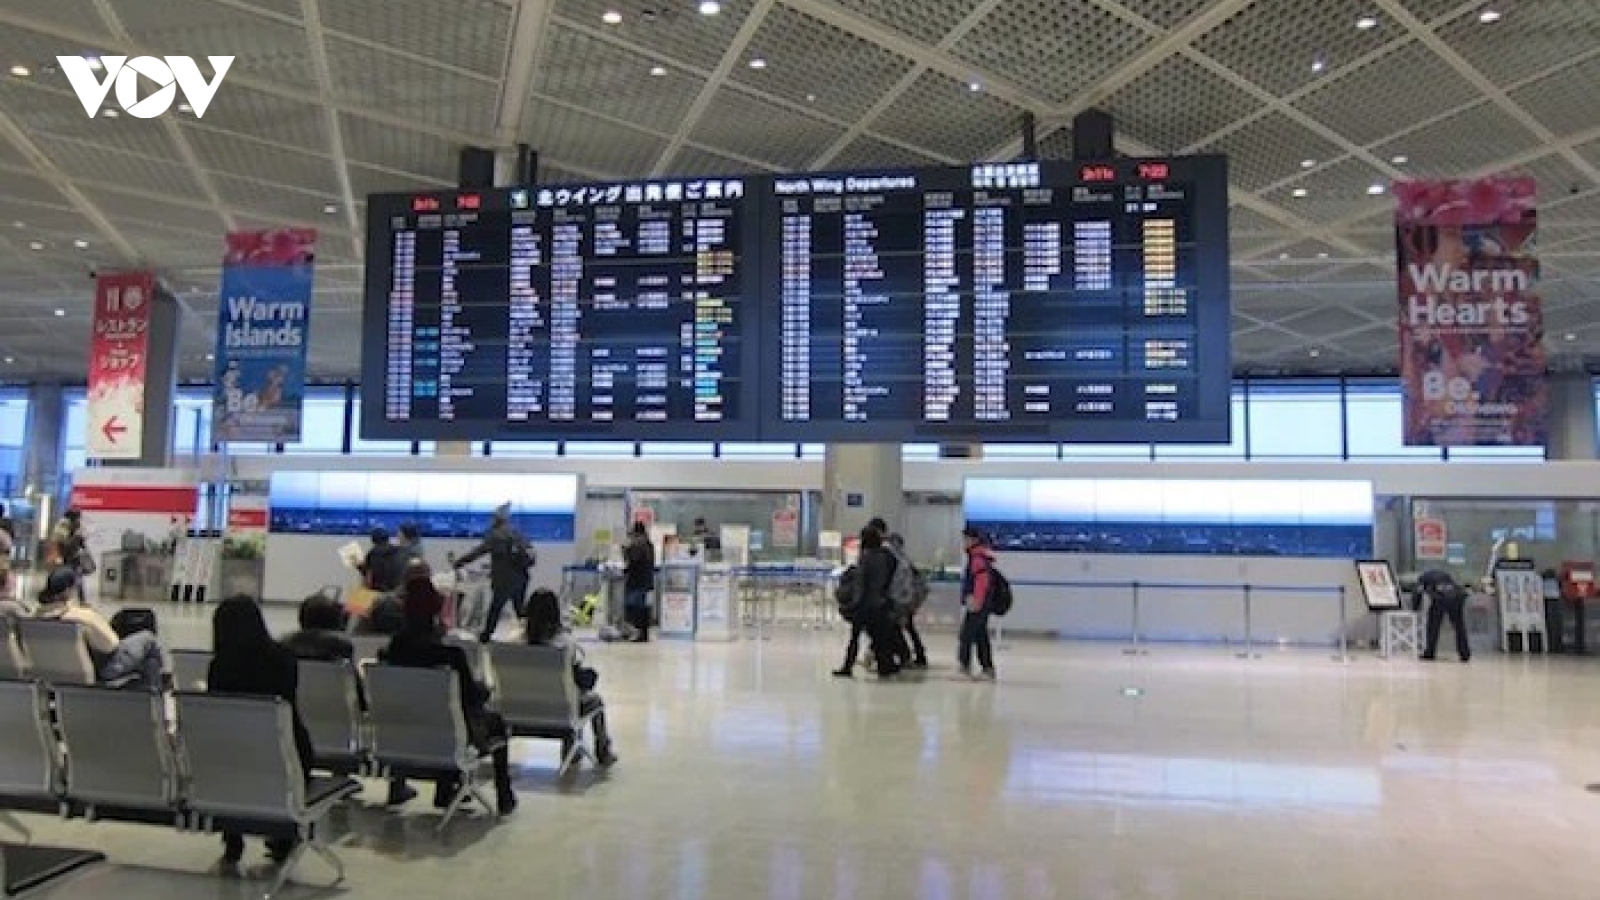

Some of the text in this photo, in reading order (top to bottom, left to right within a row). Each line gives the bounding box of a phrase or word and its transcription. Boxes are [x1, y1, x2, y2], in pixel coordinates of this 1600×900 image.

[774, 176, 916, 194] North Wing Departures
[1408, 263, 1527, 292] Warm
[228, 297, 304, 320] Warm
[1408, 297, 1529, 325] Hearts
[225, 321, 303, 346] Islands
